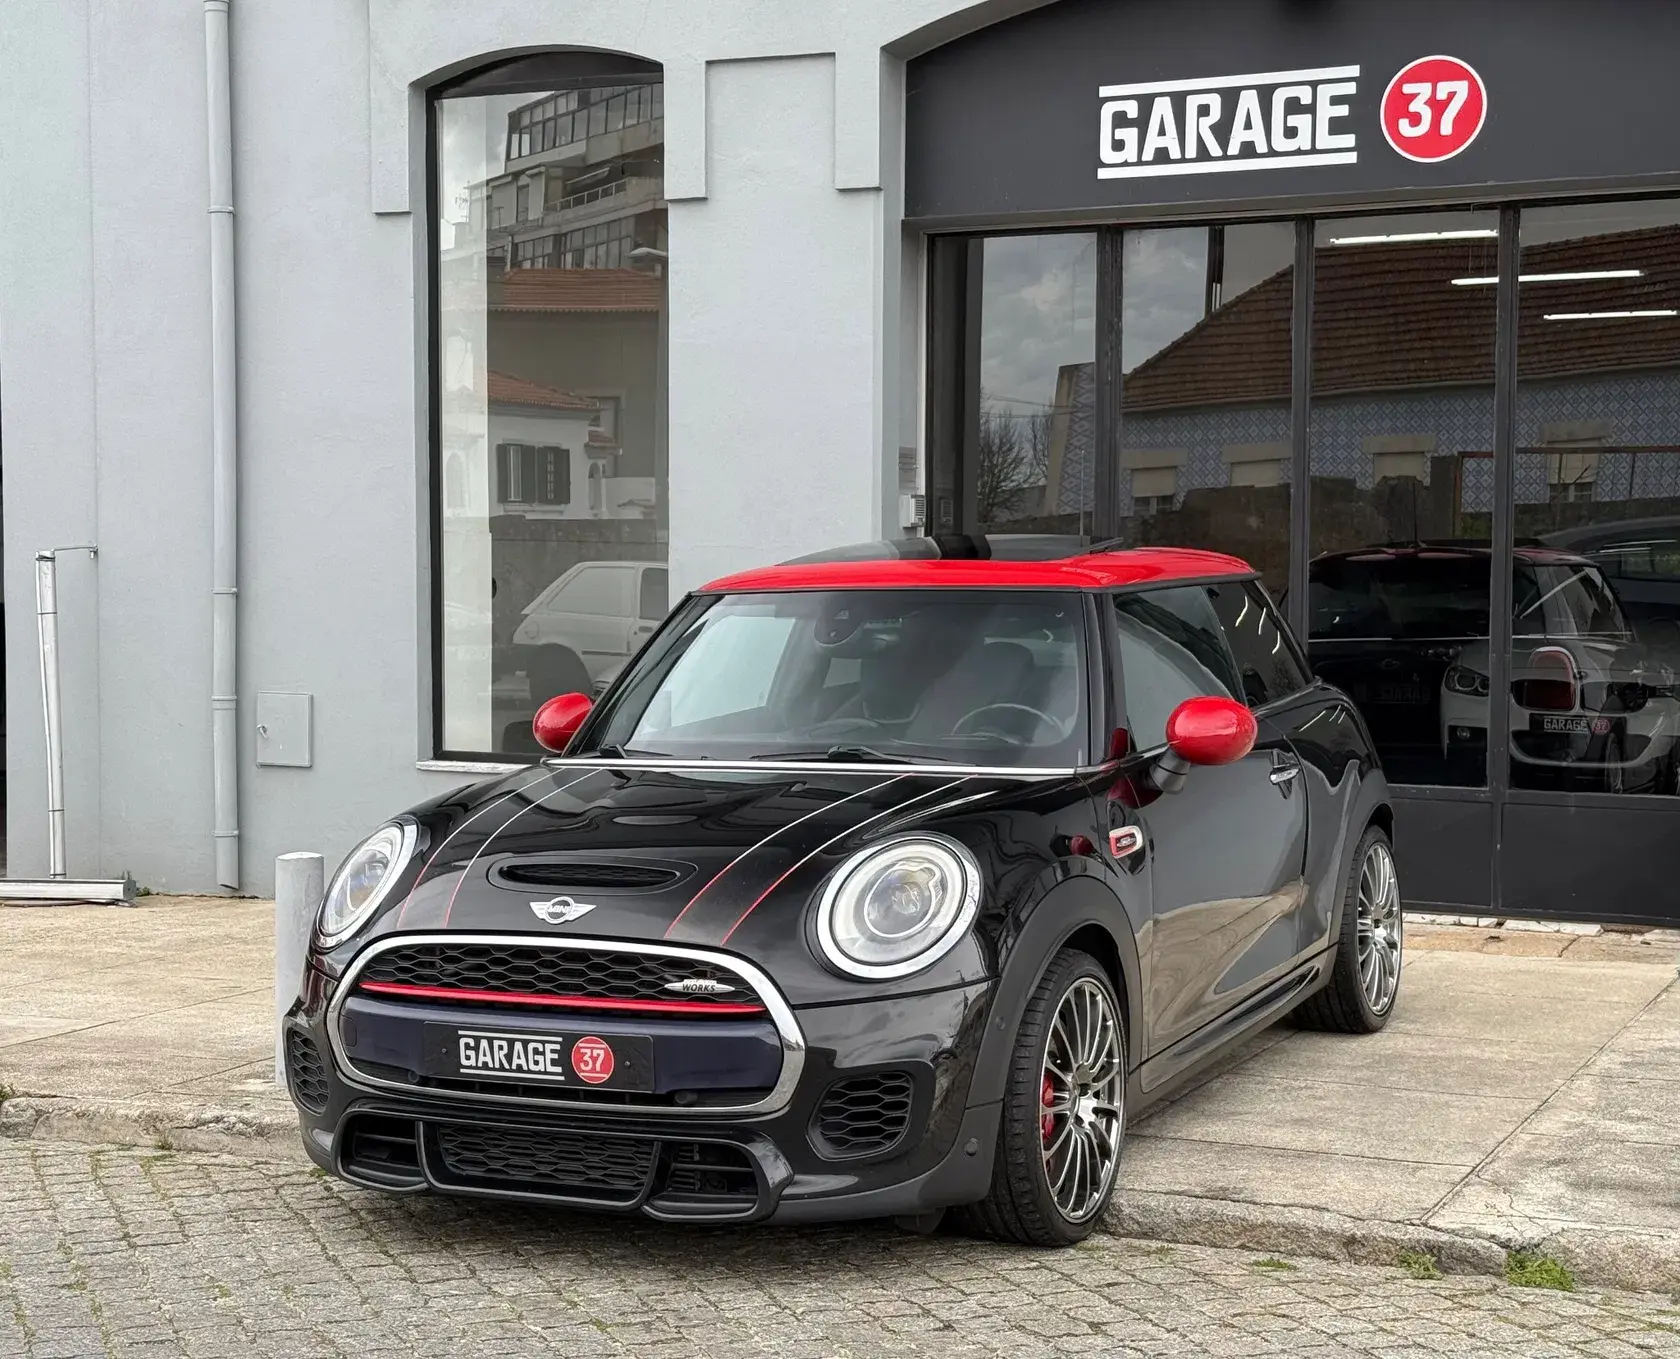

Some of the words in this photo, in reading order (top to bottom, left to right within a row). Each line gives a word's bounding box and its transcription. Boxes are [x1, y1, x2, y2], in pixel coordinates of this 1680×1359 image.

[1100, 81, 1357, 164] GARAGE
[1398, 80, 1469, 138] 37
[1543, 717, 1588, 731] GARAGE
[1593, 719, 1608, 732] 37
[682, 983, 716, 993] WORKS
[459, 1037, 562, 1073] GARAGE
[579, 1048, 606, 1072] 37
